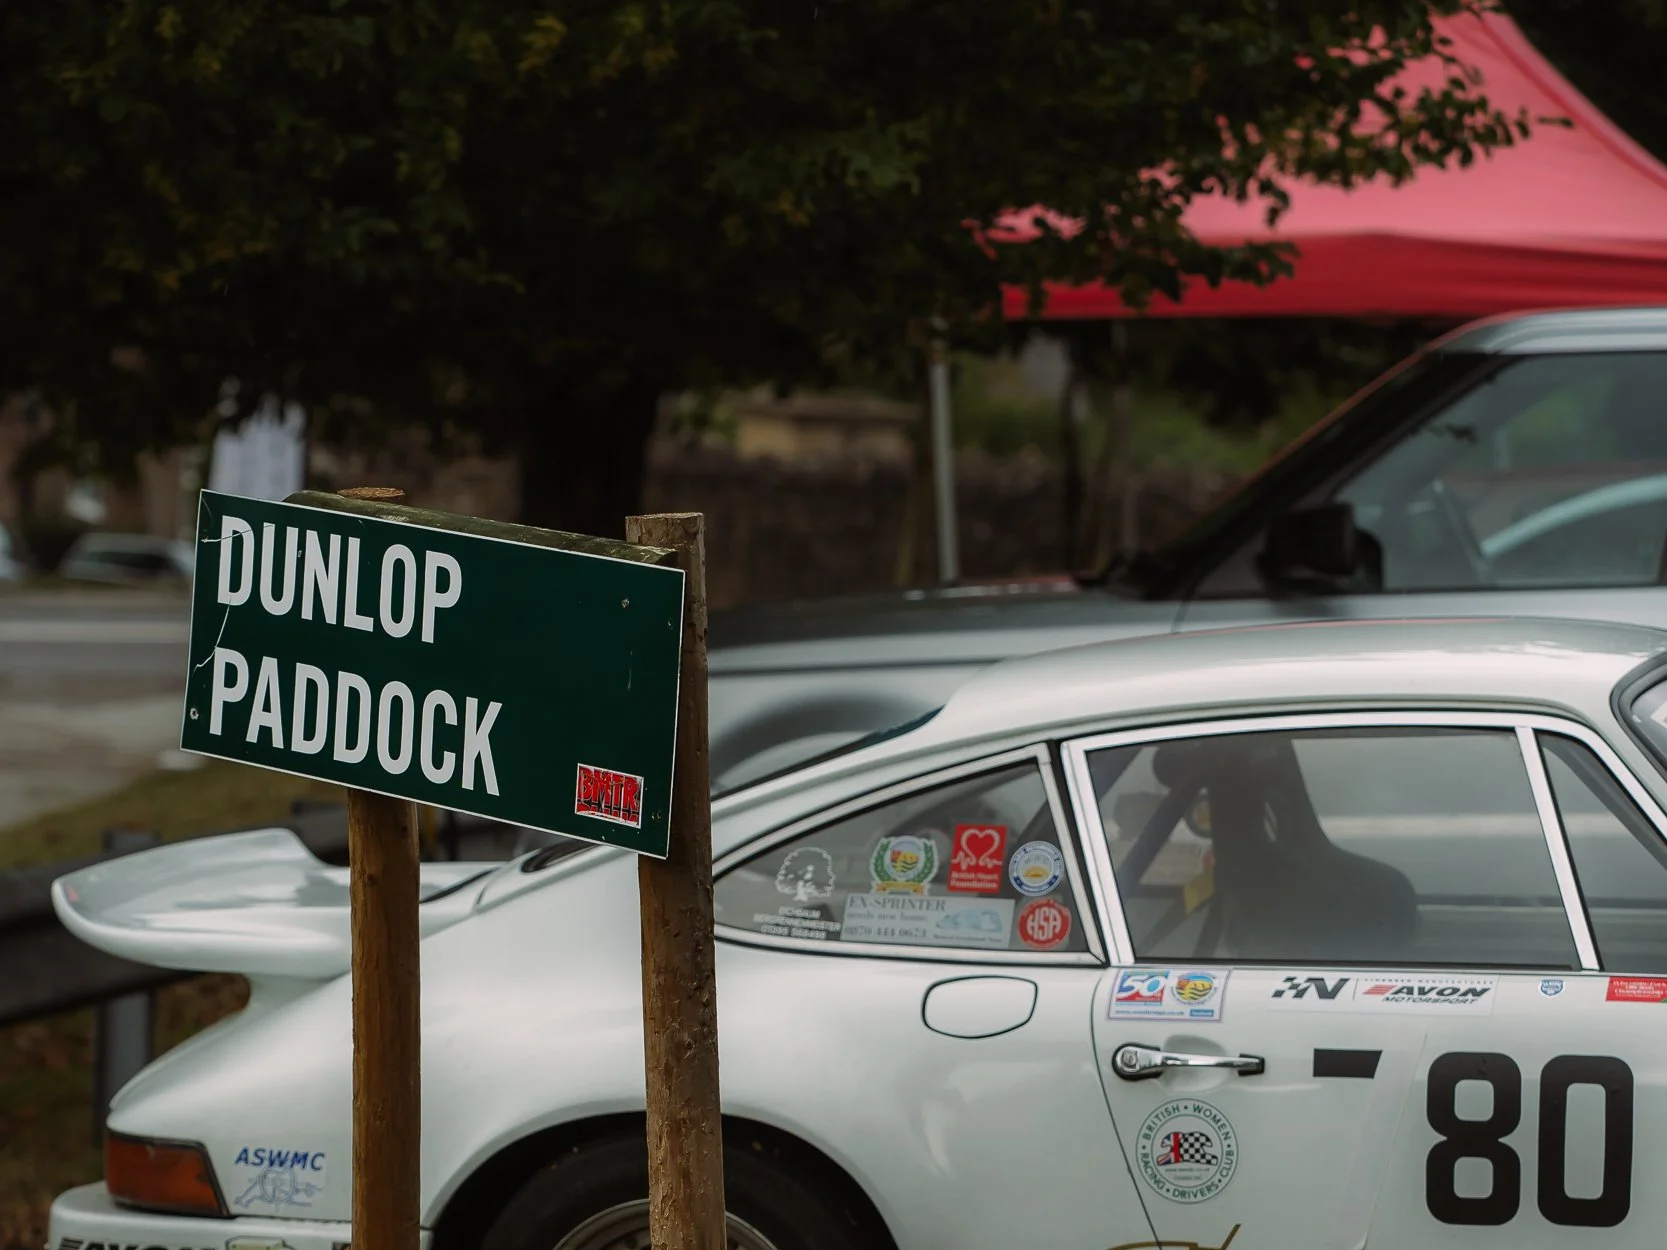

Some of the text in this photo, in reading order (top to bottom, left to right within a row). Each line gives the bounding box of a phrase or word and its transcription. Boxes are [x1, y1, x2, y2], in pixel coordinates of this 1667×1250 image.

[217, 515, 462, 643] DUNLOP
[209, 646, 502, 796] PADDOCK
[577, 767, 638, 812] BMTR
[1026, 906, 1062, 940] HSA
[1382, 996, 1479, 1005] MOTORSPORT
[1390, 985, 1491, 997] AVON
[1142, 1103, 1231, 1141] BRITISH WOMEN
[1426, 1051, 1634, 1228] 80
[235, 1147, 326, 1172] ASWMC
[1141, 1150, 1234, 1200] RACING DRIVERS CLUB
